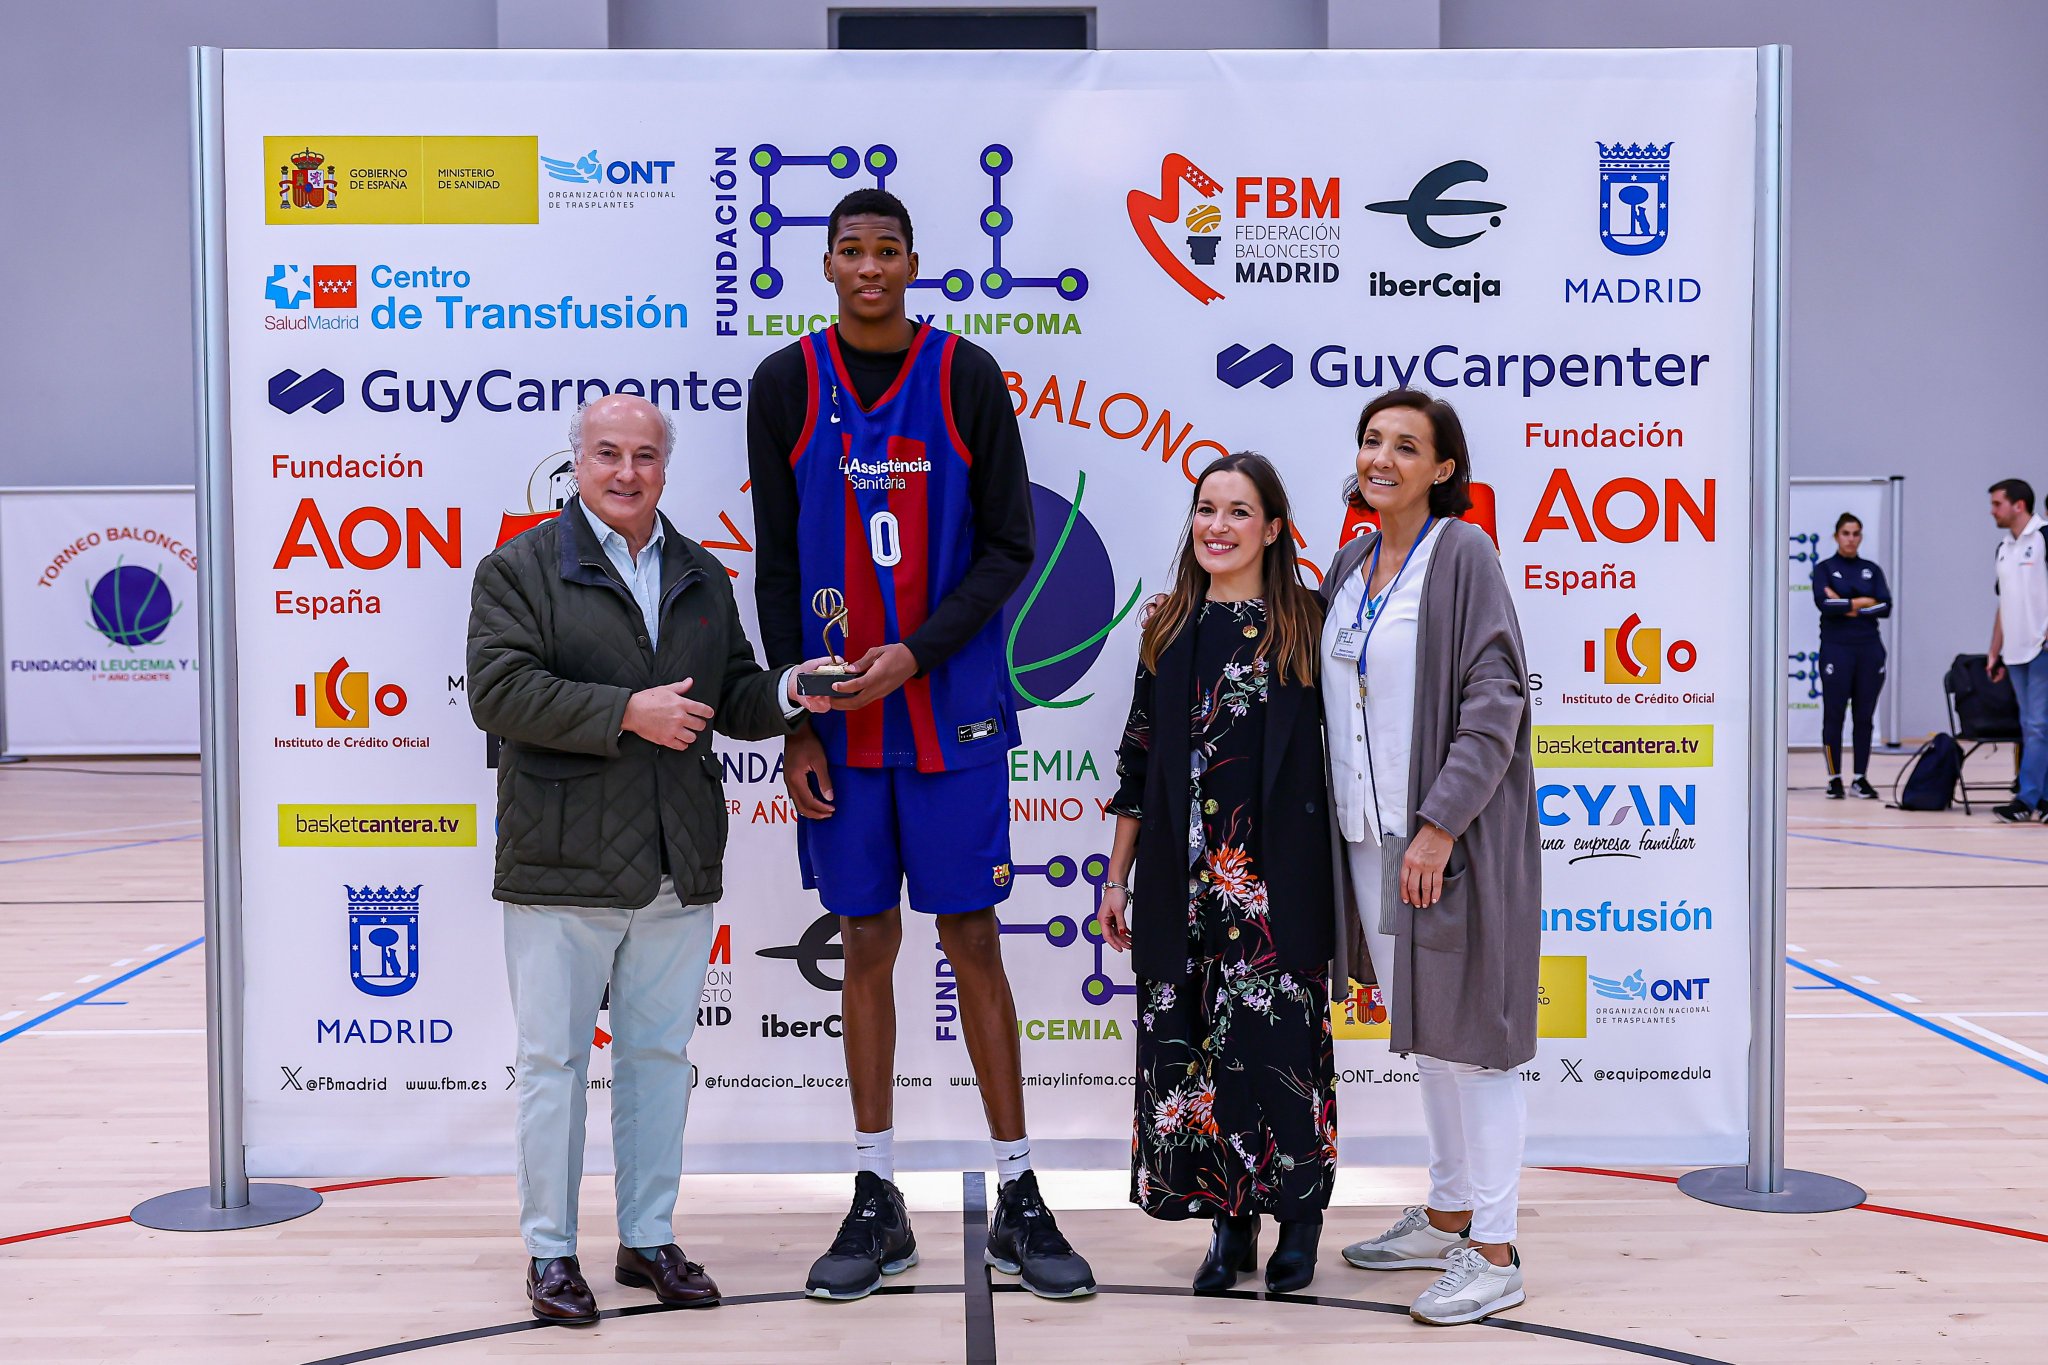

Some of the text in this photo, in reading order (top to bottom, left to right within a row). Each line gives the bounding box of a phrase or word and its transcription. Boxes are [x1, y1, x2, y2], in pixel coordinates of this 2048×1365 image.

[349, 169, 408, 178] GOBIERNO
[438, 169, 495, 178] MINISTERIO
[606, 160, 676, 185] ONT
[349, 178, 408, 190] DE ESPAÑA
[438, 181, 501, 189] DE SANIDAD
[548, 190, 623, 199] ORGANIZACIÓN
[566, 201, 635, 209] TRASPLANTES
[1235, 177, 1340, 218] FBM
[710, 147, 738, 336] FUNDACIÓN
[1235, 223, 1340, 240] FEDERACIÓN
[1235, 244, 1340, 259] BALONCESTO
[371, 264, 471, 288] Centro
[1235, 263, 1340, 283] MADRID
[1369, 271, 1501, 303] iberCaja
[1565, 279, 1702, 303] MADRID
[371, 294, 688, 330] de Transfusión
[264, 315, 359, 331] SaludMadrid
[946, 313, 1082, 335] LINFOMA
[1309, 344, 1710, 397] GuyCarpenter
[1525, 422, 1683, 447] Fundación
[273, 453, 423, 478] Fundación
[849, 457, 932, 475] Assistència
[850, 474, 906, 490] Sanitària
[1523, 468, 1716, 544] AON
[273, 498, 462, 570] AON
[869, 511, 902, 567] 0
[38, 532, 101, 588] TORNEO
[1524, 564, 1636, 595] España
[275, 589, 381, 620] España
[11, 659, 97, 672] FUNDACIÓN
[100, 659, 175, 671] LEUCEMIA
[179, 659, 189, 670] Y
[1562, 692, 1715, 704] Instituto de Crédito Oficial
[274, 736, 430, 748] Instituto de Crédito Oficial
[1537, 735, 1699, 754] basketcantera.tv
[1008, 797, 1083, 822] NINO
[296, 813, 459, 833] basketcantera.tv
[1573, 836, 1631, 857] empresa
[1638, 828, 1696, 851] familiar
[1650, 978, 1710, 1001] ONT
[1596, 1006, 1710, 1015] ORGANIZACIÓN NACIONAL
[1612, 1016, 1676, 1024] TRASPLANTES
[317, 1019, 453, 1044] MADRID
[306, 1077, 387, 1091] @FBmadrid
[405, 1078, 487, 1091] www.fbm.es
[1594, 1066, 1711, 1083] @equipomedula
